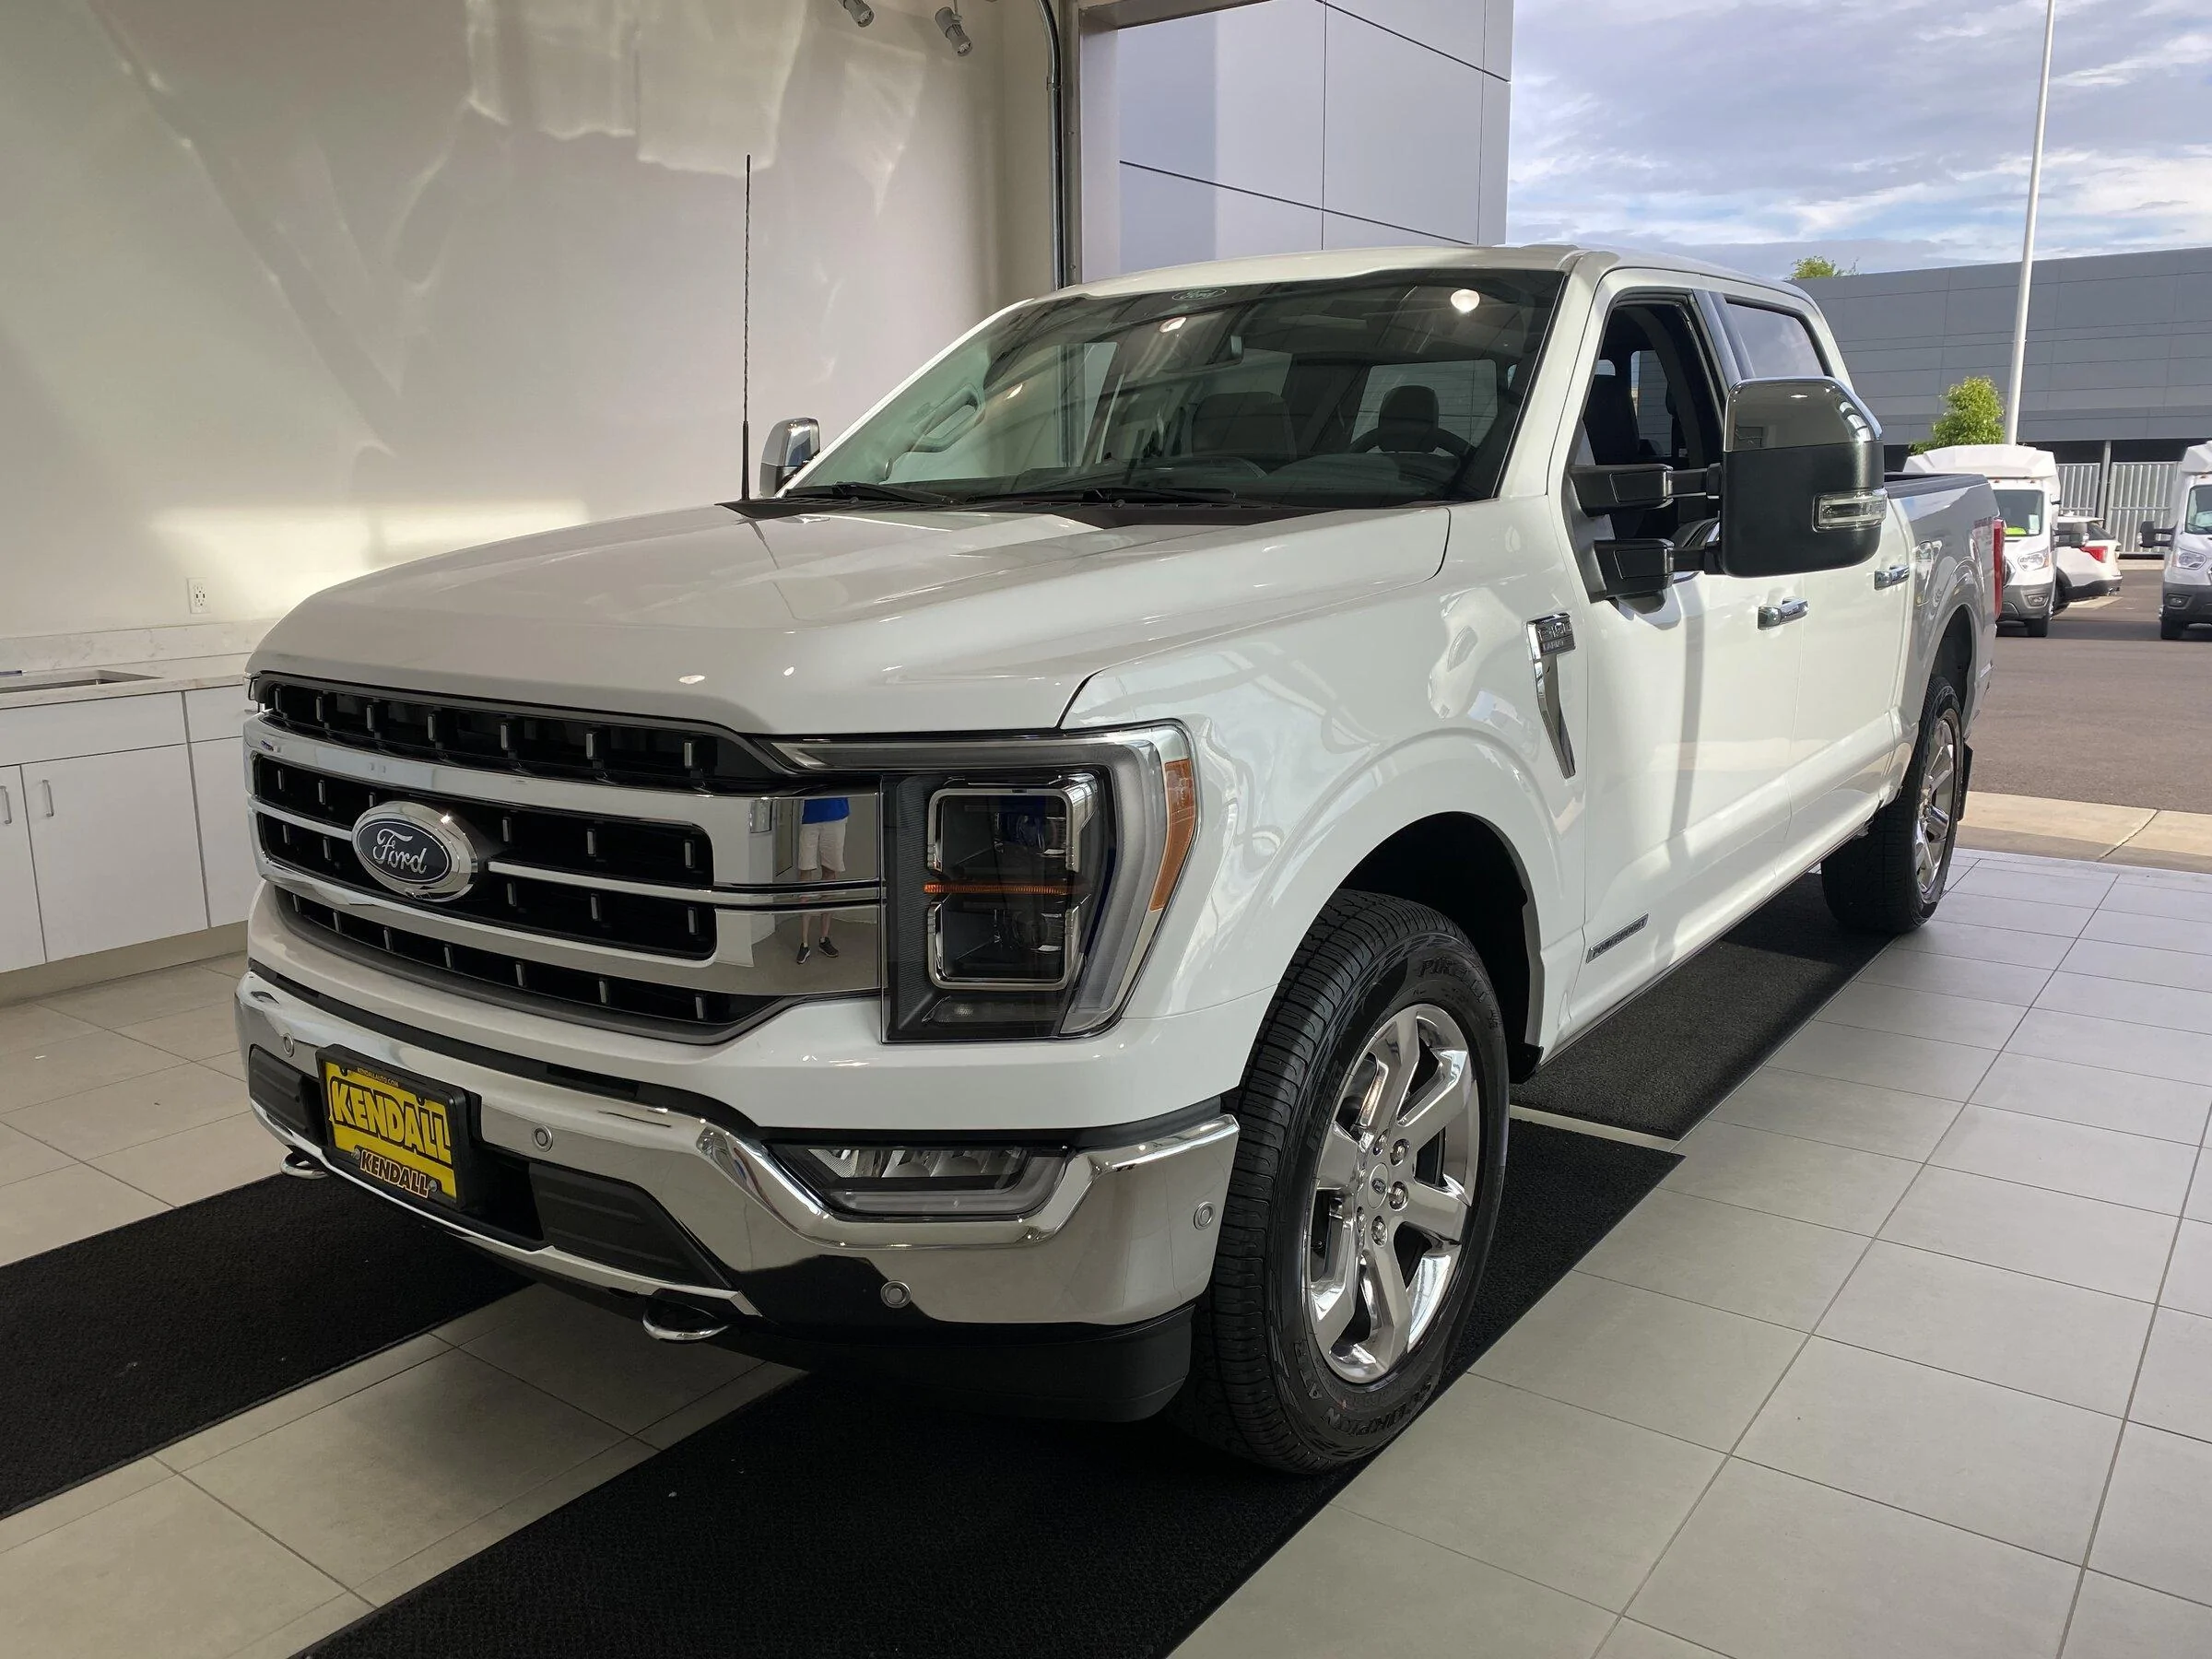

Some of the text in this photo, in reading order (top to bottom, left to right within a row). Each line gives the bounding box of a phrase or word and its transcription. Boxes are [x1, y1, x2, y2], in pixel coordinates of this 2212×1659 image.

[372, 829, 428, 875] Ford
[330, 1076, 453, 1166] KENDALL
[359, 1149, 429, 1199] KENDALL
